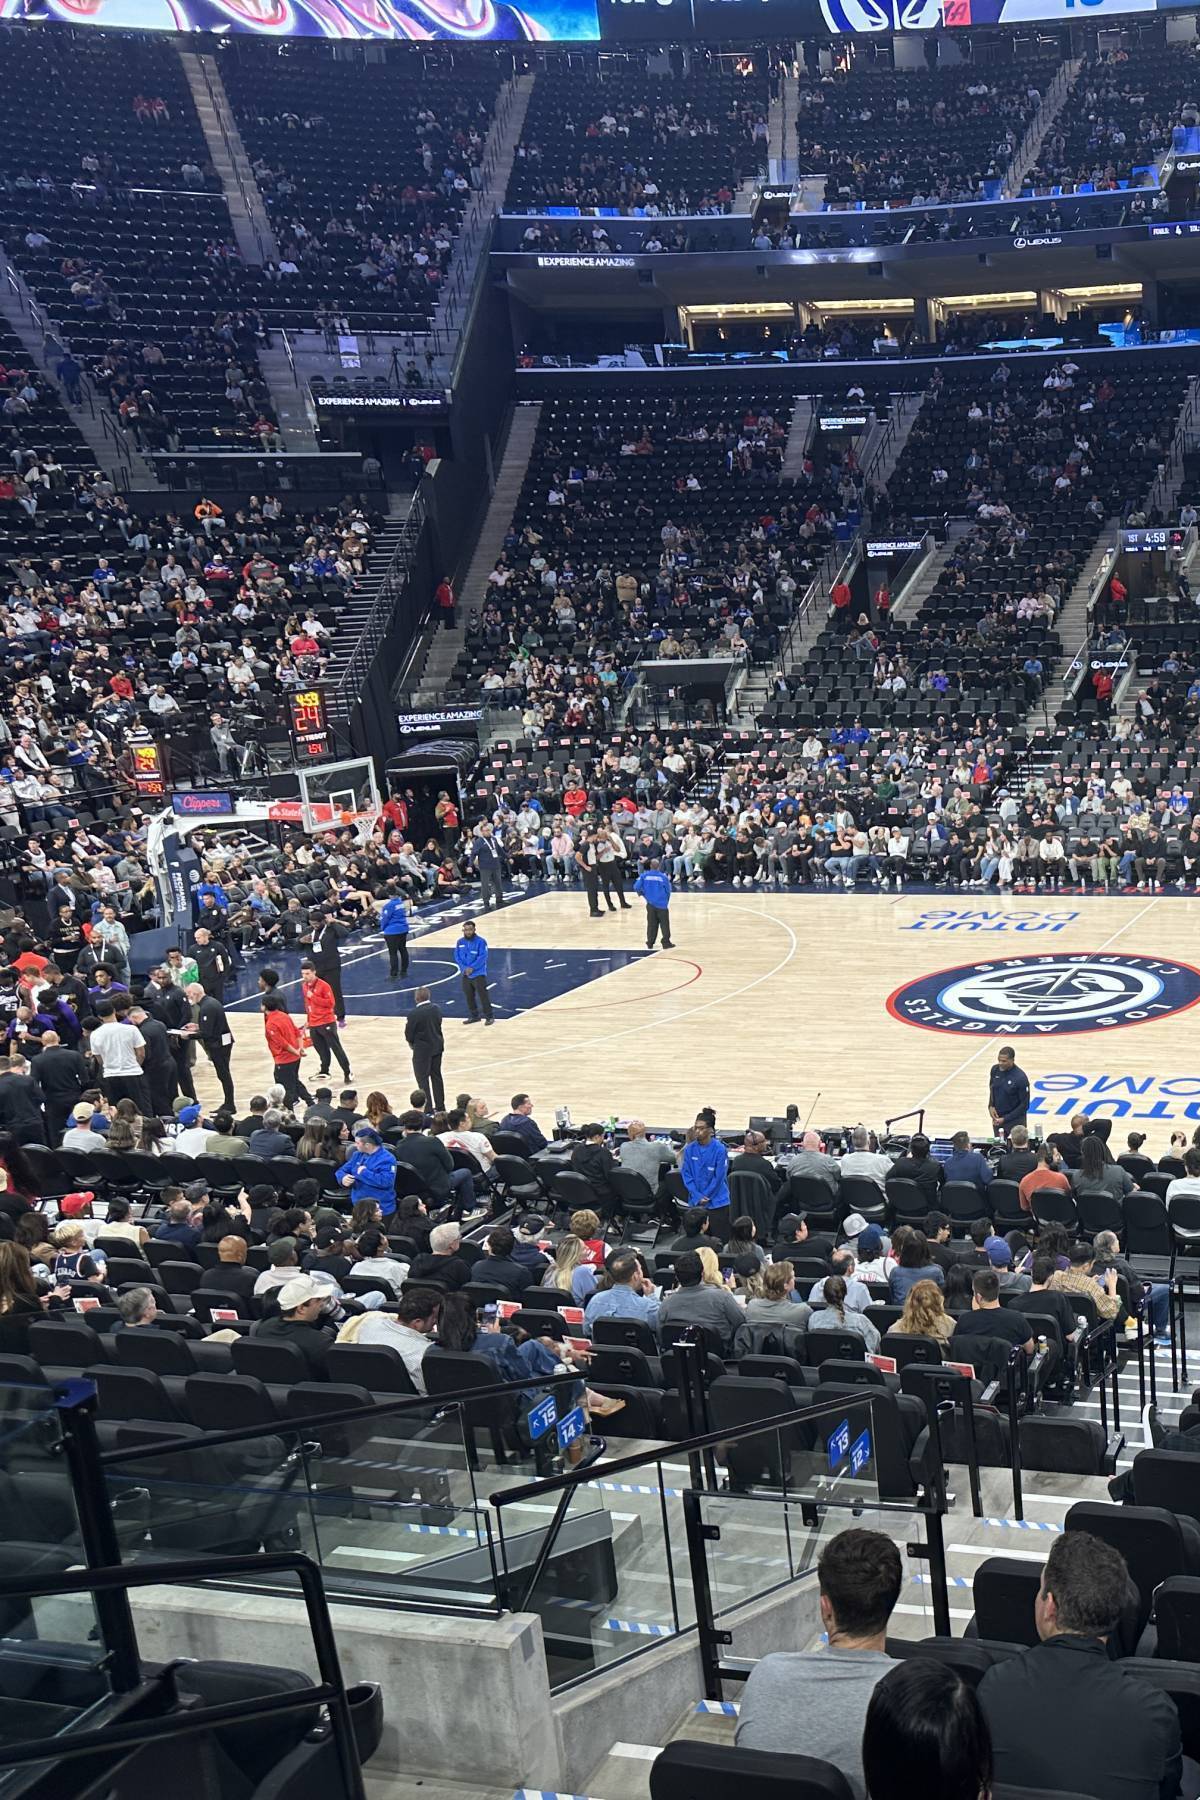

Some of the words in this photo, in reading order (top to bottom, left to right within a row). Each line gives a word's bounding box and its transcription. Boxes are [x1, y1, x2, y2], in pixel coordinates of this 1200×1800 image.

[1176, 225, 1182, 235] 4
[1027, 237, 1062, 246] LEXUS
[544, 258, 594, 266] EXPERIENCE
[595, 258, 636, 266] AMAZING
[1128, 534, 1139, 542] 1ST
[1145, 532, 1166, 543] 4:59
[294, 706, 320, 730] 24
[398, 712, 446, 722] EXPERIENCE
[446, 710, 482, 720] AMAZING
[305, 732, 327, 741] TISSOT
[140, 758, 155, 770] 24
[184, 796, 221, 810] Clippers
[176, 872, 187, 911] PECHANGA
[897, 921, 1068, 933] INTUIT
[974, 955, 1181, 975] CLIPPERS
[904, 998, 1059, 1032] ANGELES
[1095, 1002, 1174, 1027] LOS
[542, 1405, 556, 1427] 15
[562, 1423, 576, 1444] 14
[838, 1432, 849, 1454] 13
[852, 1449, 864, 1471] 12
